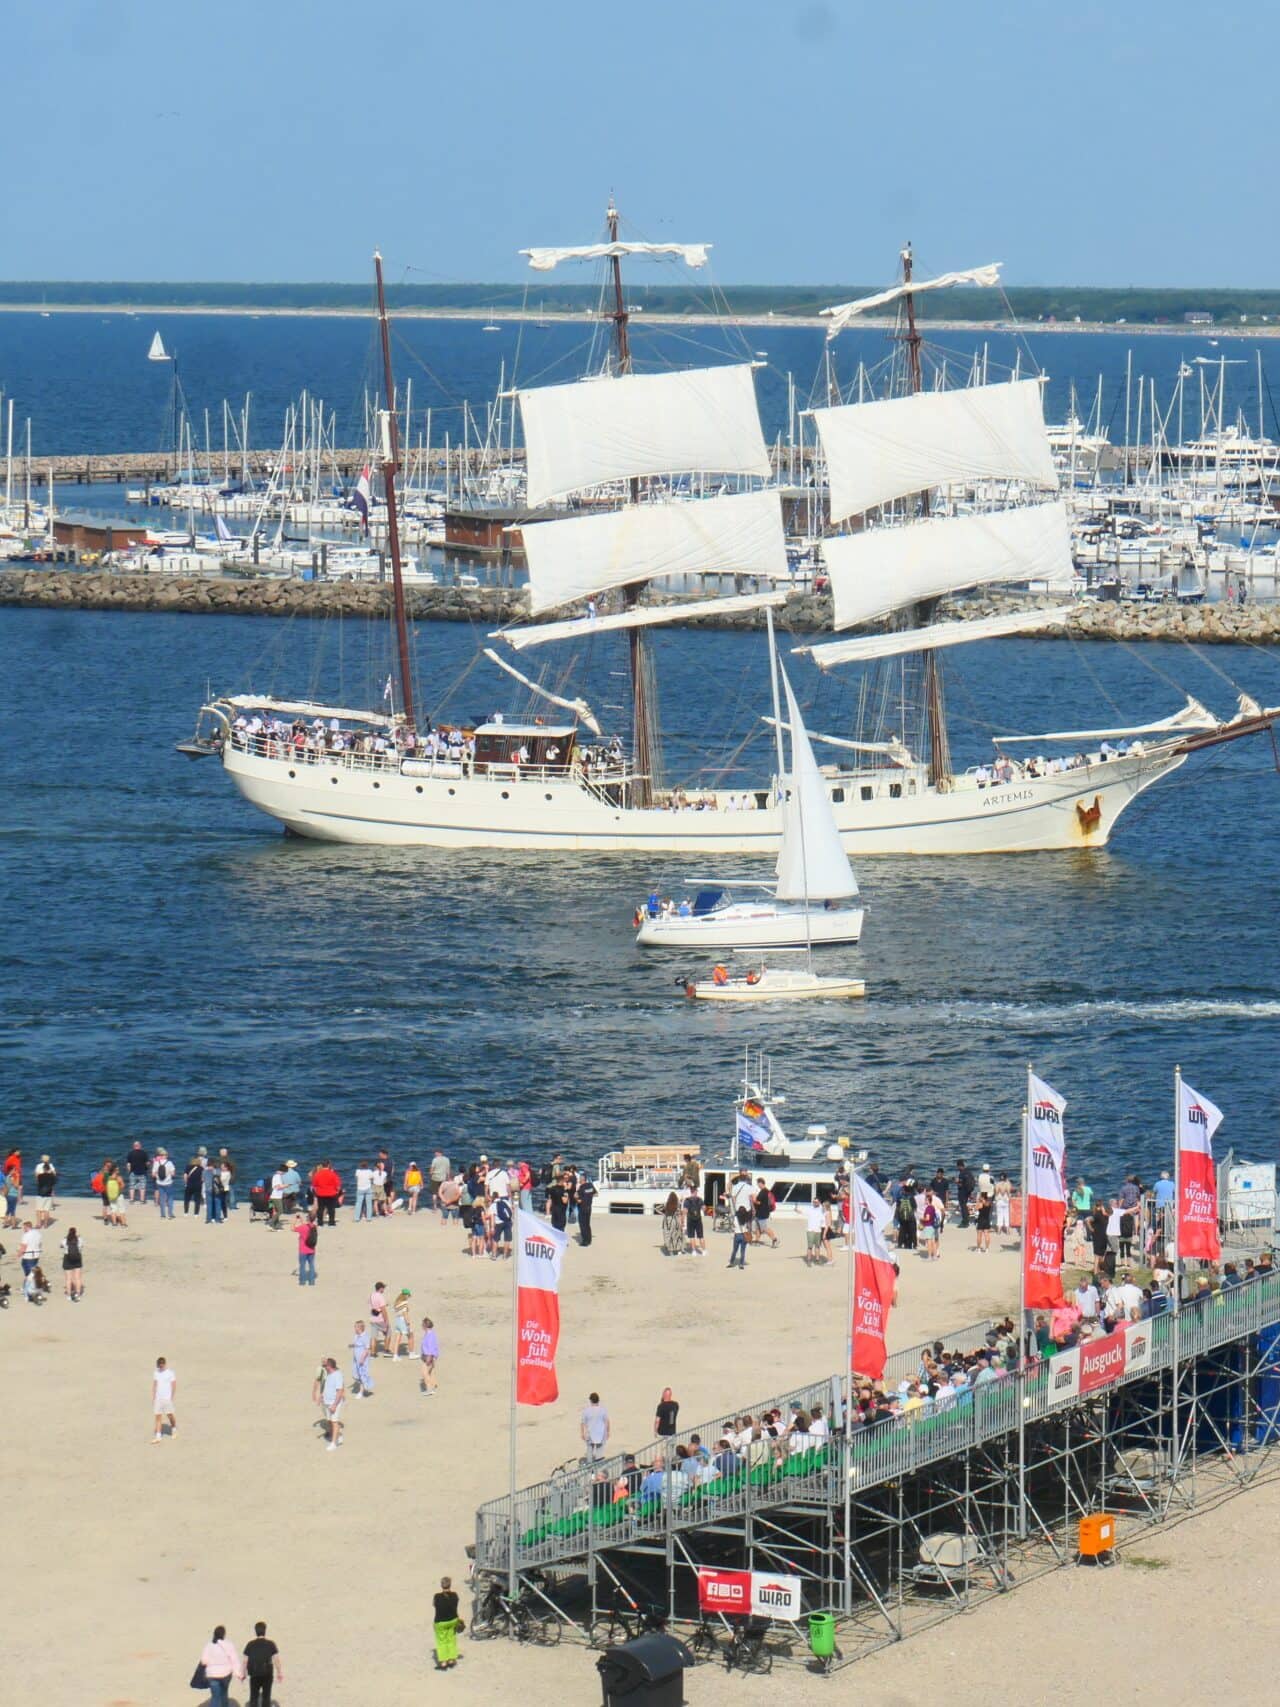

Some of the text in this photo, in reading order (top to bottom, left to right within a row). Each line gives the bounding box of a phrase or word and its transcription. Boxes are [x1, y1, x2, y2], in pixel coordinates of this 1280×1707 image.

[983, 789, 1033, 807] ARTEMIS
[525, 1241, 556, 1261] WIRO
[1082, 1343, 1122, 1376] Ausguck
[758, 1589, 792, 1607] WIRO
